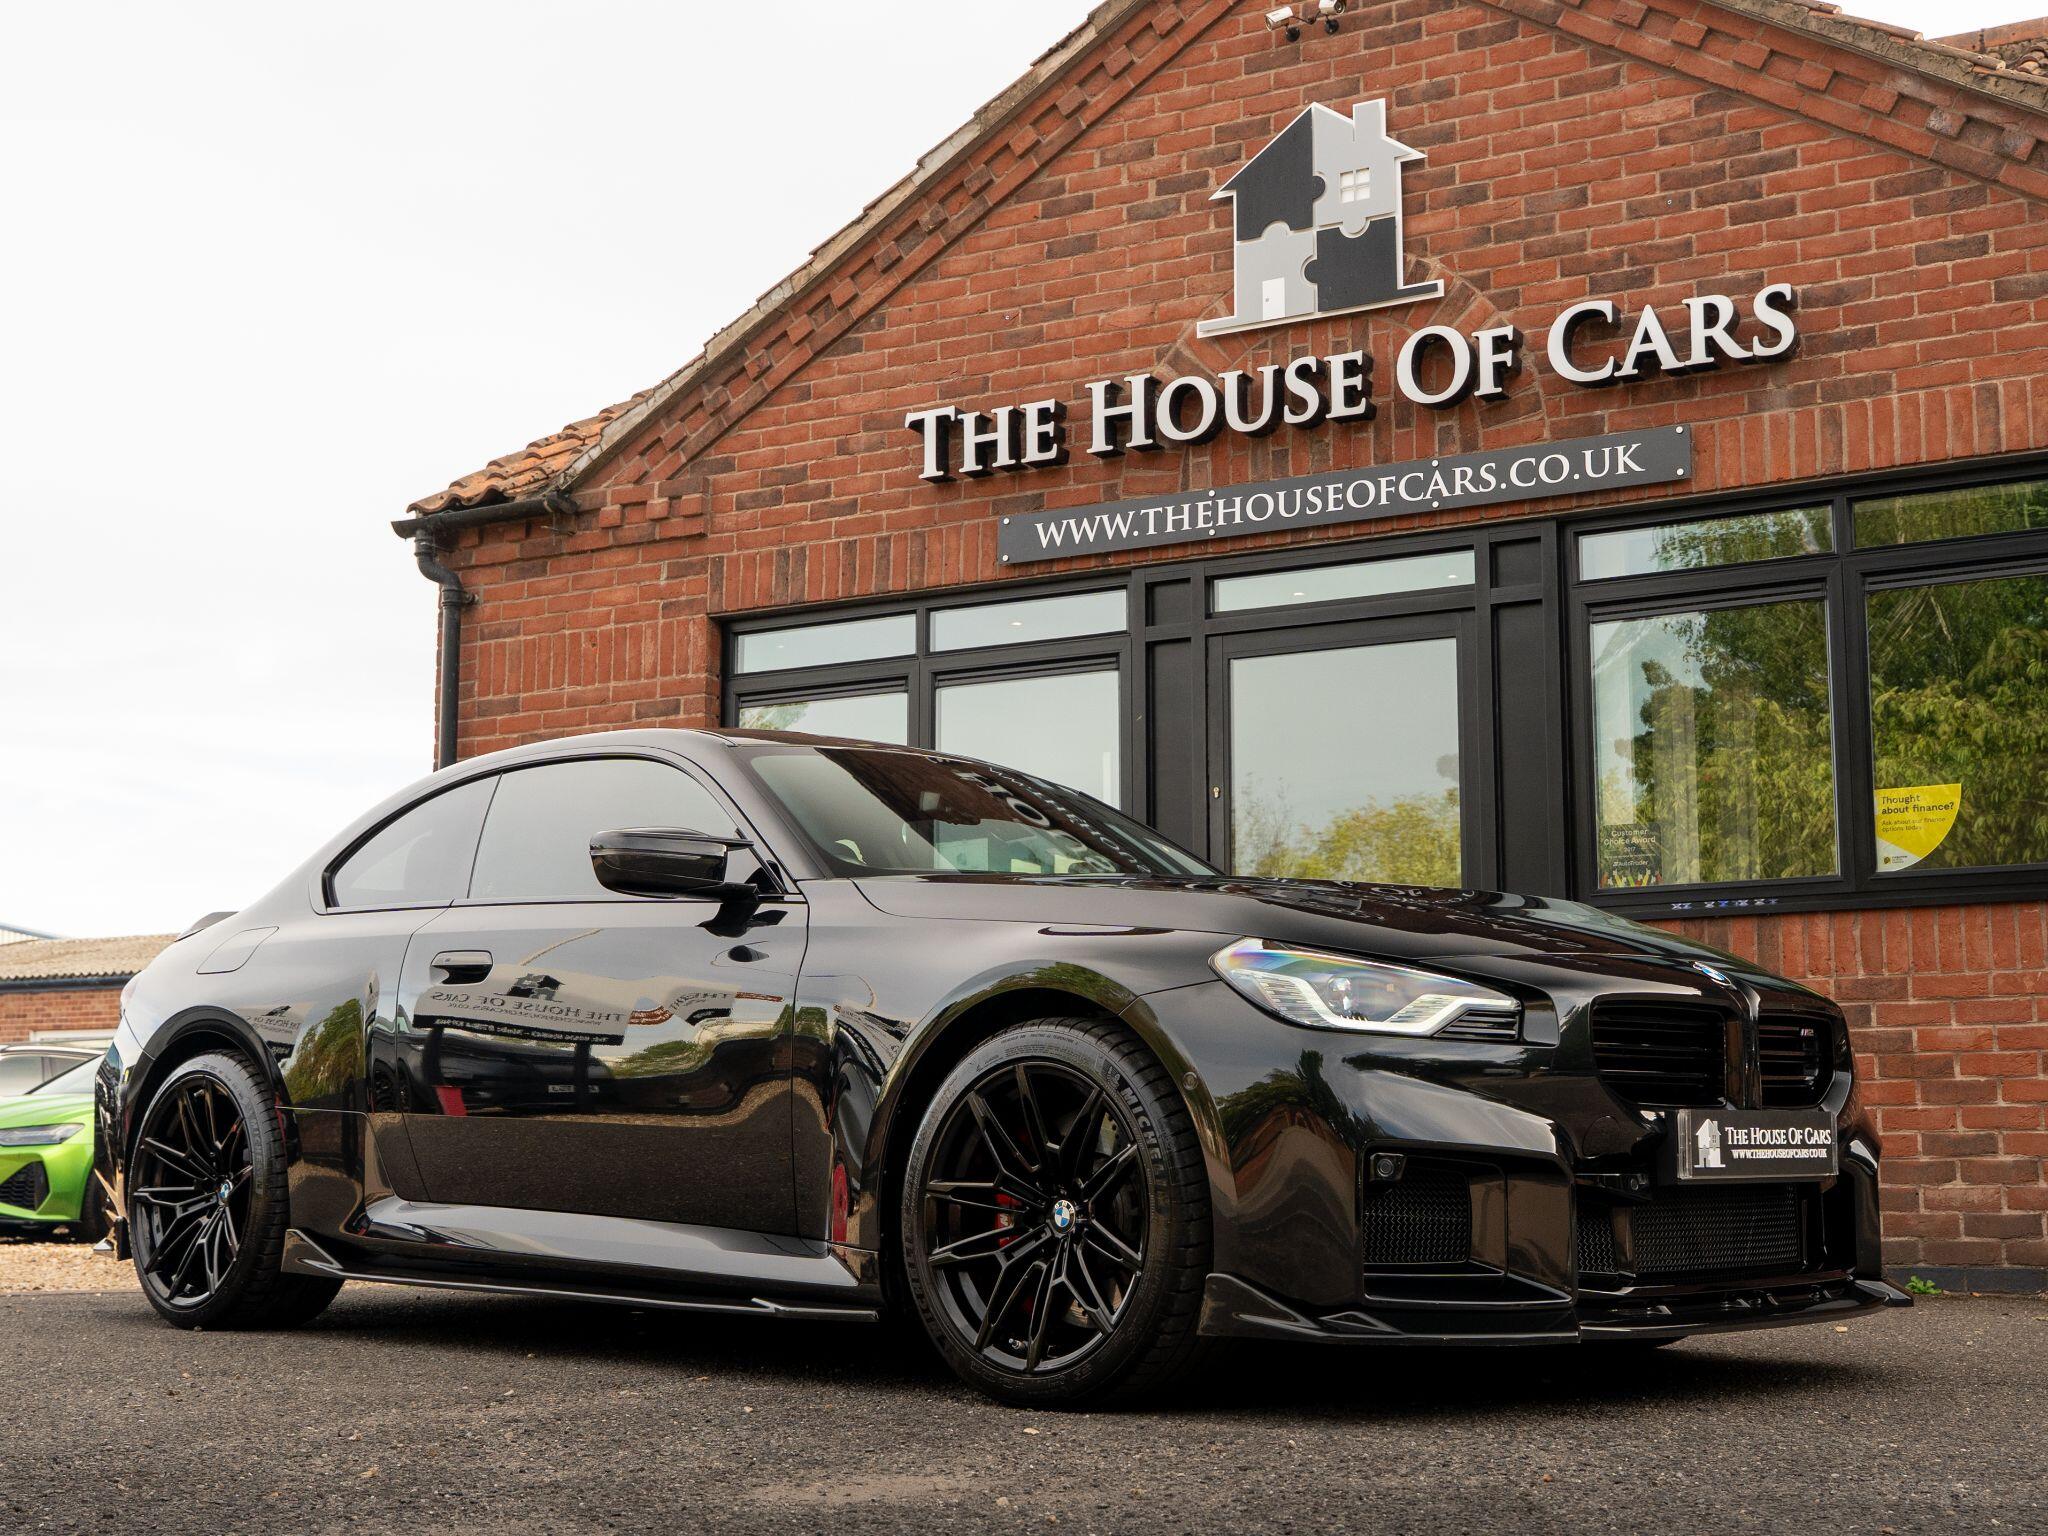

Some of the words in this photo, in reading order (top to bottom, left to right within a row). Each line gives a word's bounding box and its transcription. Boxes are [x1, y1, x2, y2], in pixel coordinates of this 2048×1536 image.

[904, 398, 1058, 481] THE
[1084, 349, 1367, 454] HOUSE
[1396, 325, 1514, 404] OF
[1547, 283, 1794, 382] CARS
[1034, 442, 1646, 549] WWW.THEHOUSEOFCARS.CO.UK
[1881, 795, 1920, 804] Thought
[1881, 806, 1909, 815] about
[1912, 802, 1954, 813] finance?
[1611, 829, 1648, 837] Customer
[1603, 837, 1630, 846] Choice
[1630, 836, 1656, 845] Award
[1724, 1126, 1749, 1145] THE
[1750, 1127, 1787, 1145] HOUSE
[1788, 1127, 1803, 1145] OF
[1804, 1127, 1832, 1145] CARS
